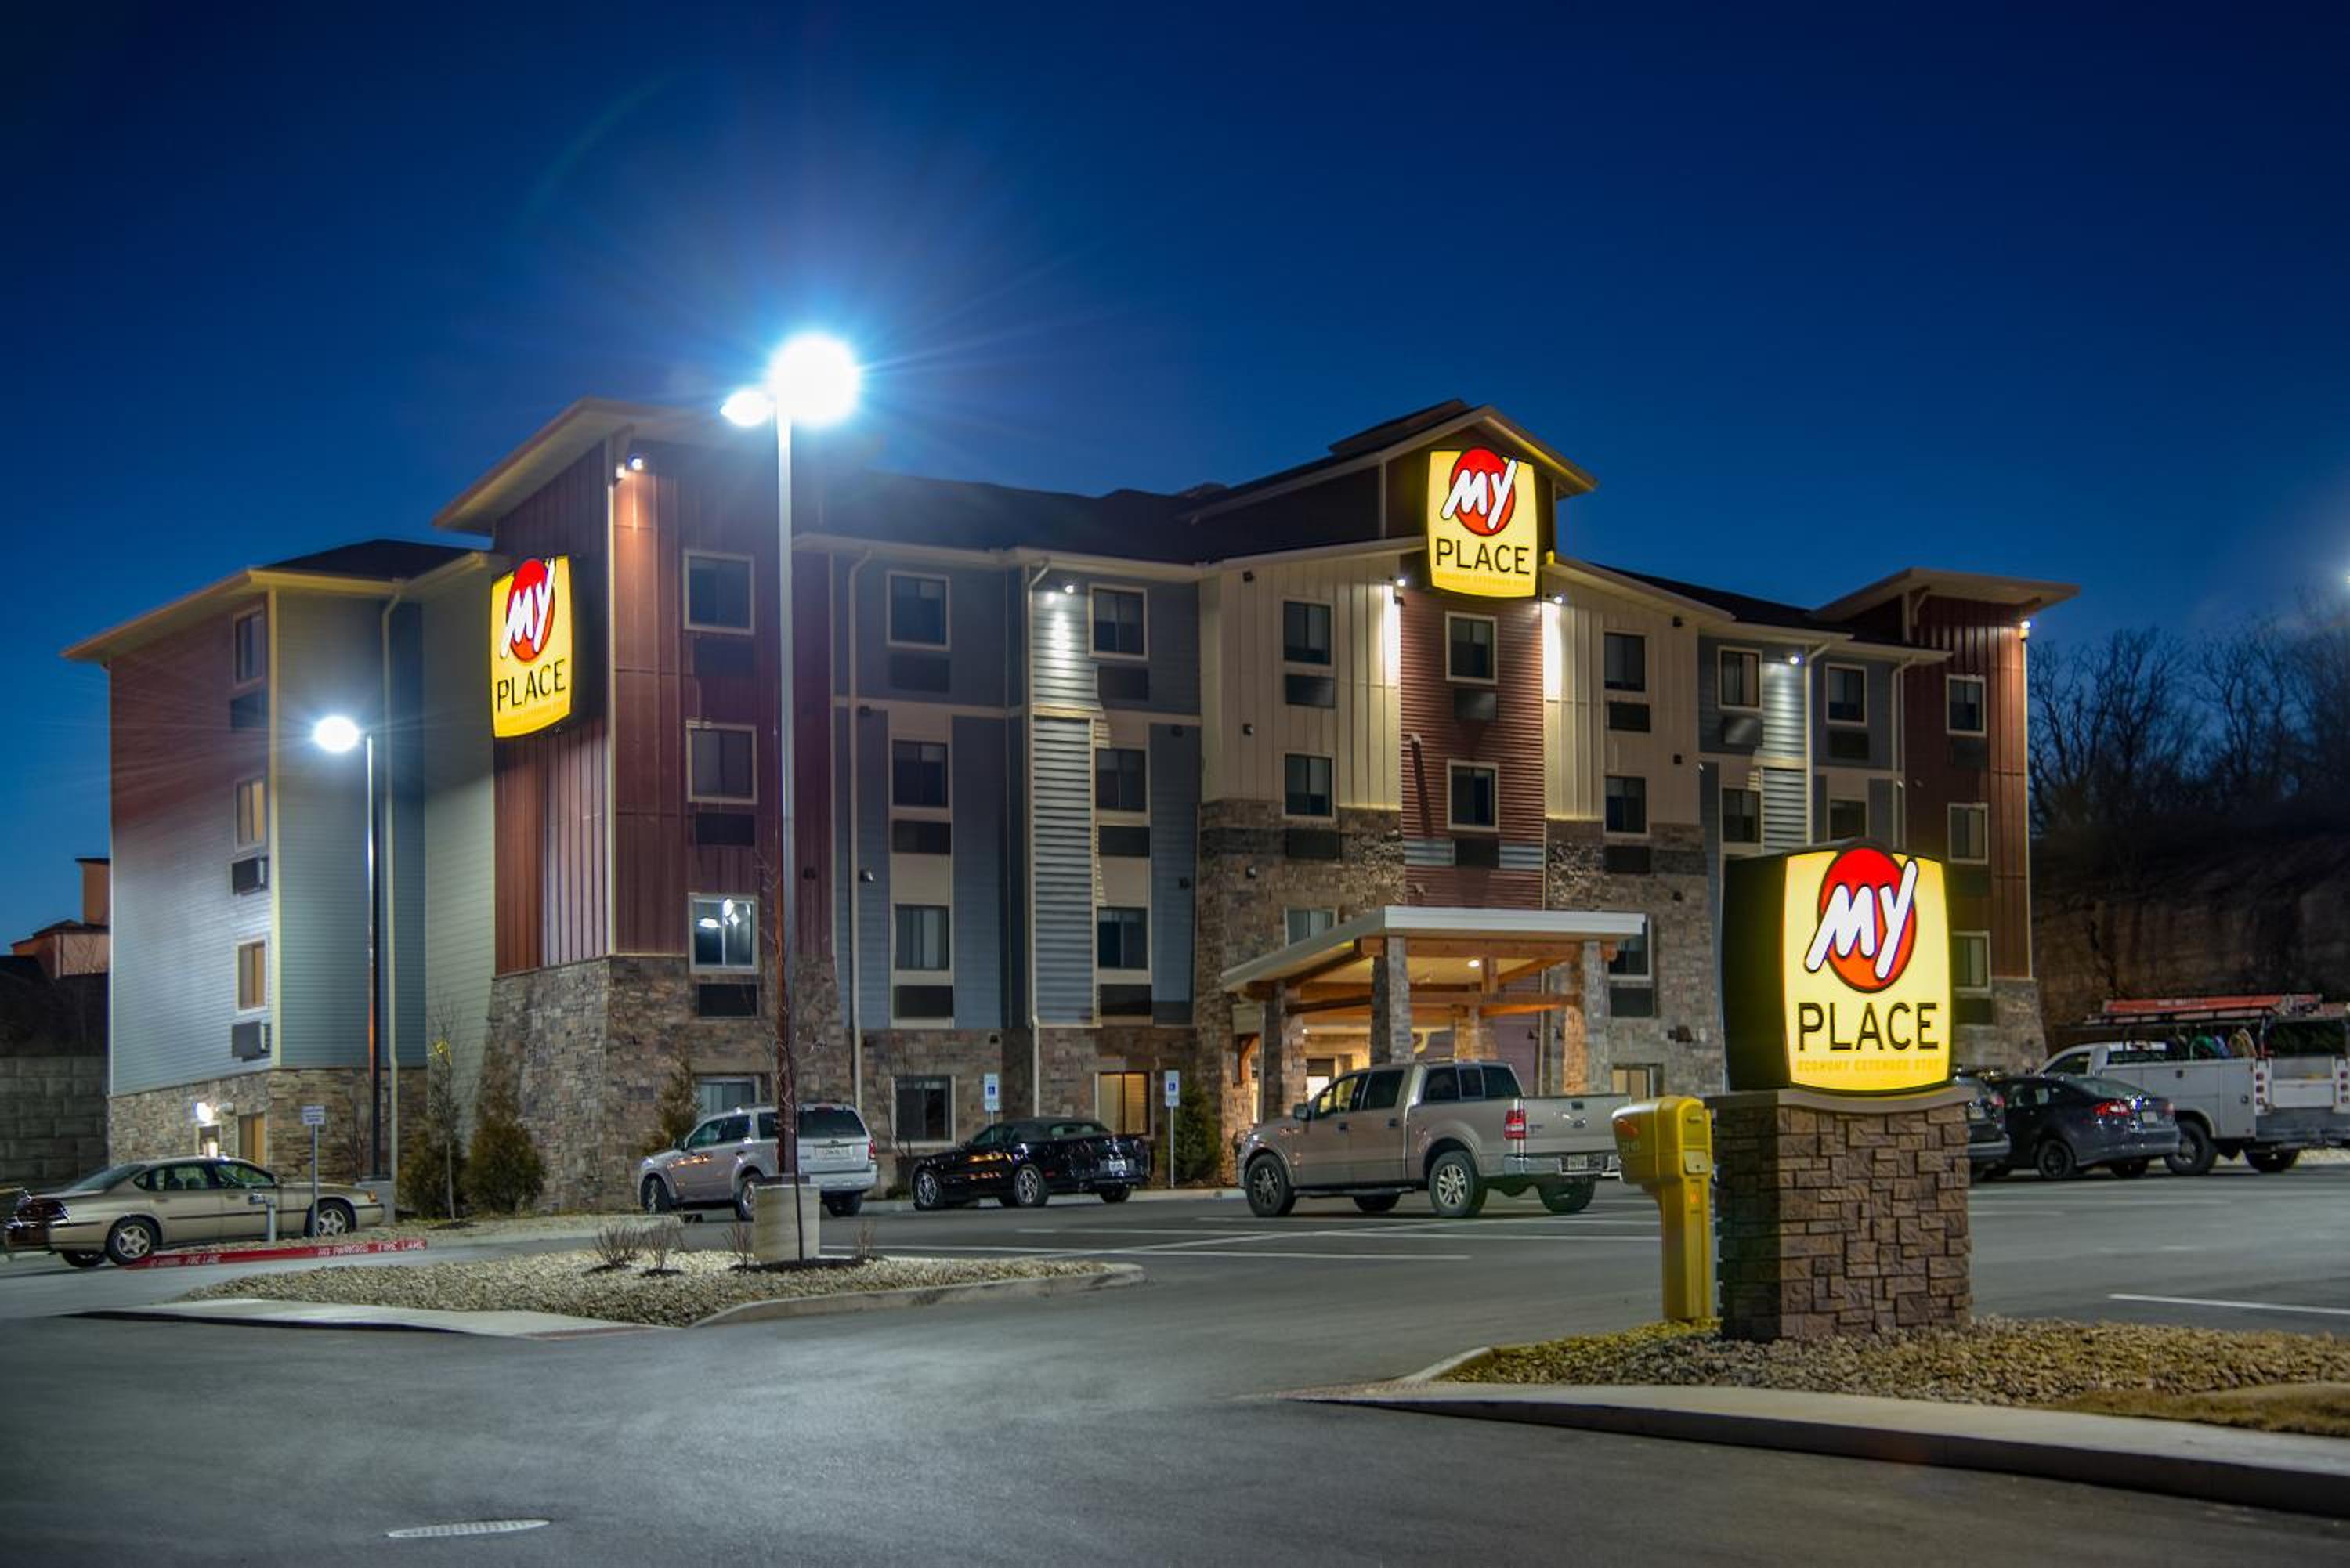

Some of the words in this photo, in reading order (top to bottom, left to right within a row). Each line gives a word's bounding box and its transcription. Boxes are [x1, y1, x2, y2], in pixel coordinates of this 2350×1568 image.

[1436, 538, 1530, 576] PLACE
[497, 659, 566, 713] PLACE
[1798, 1002, 1939, 1050] PLACE
